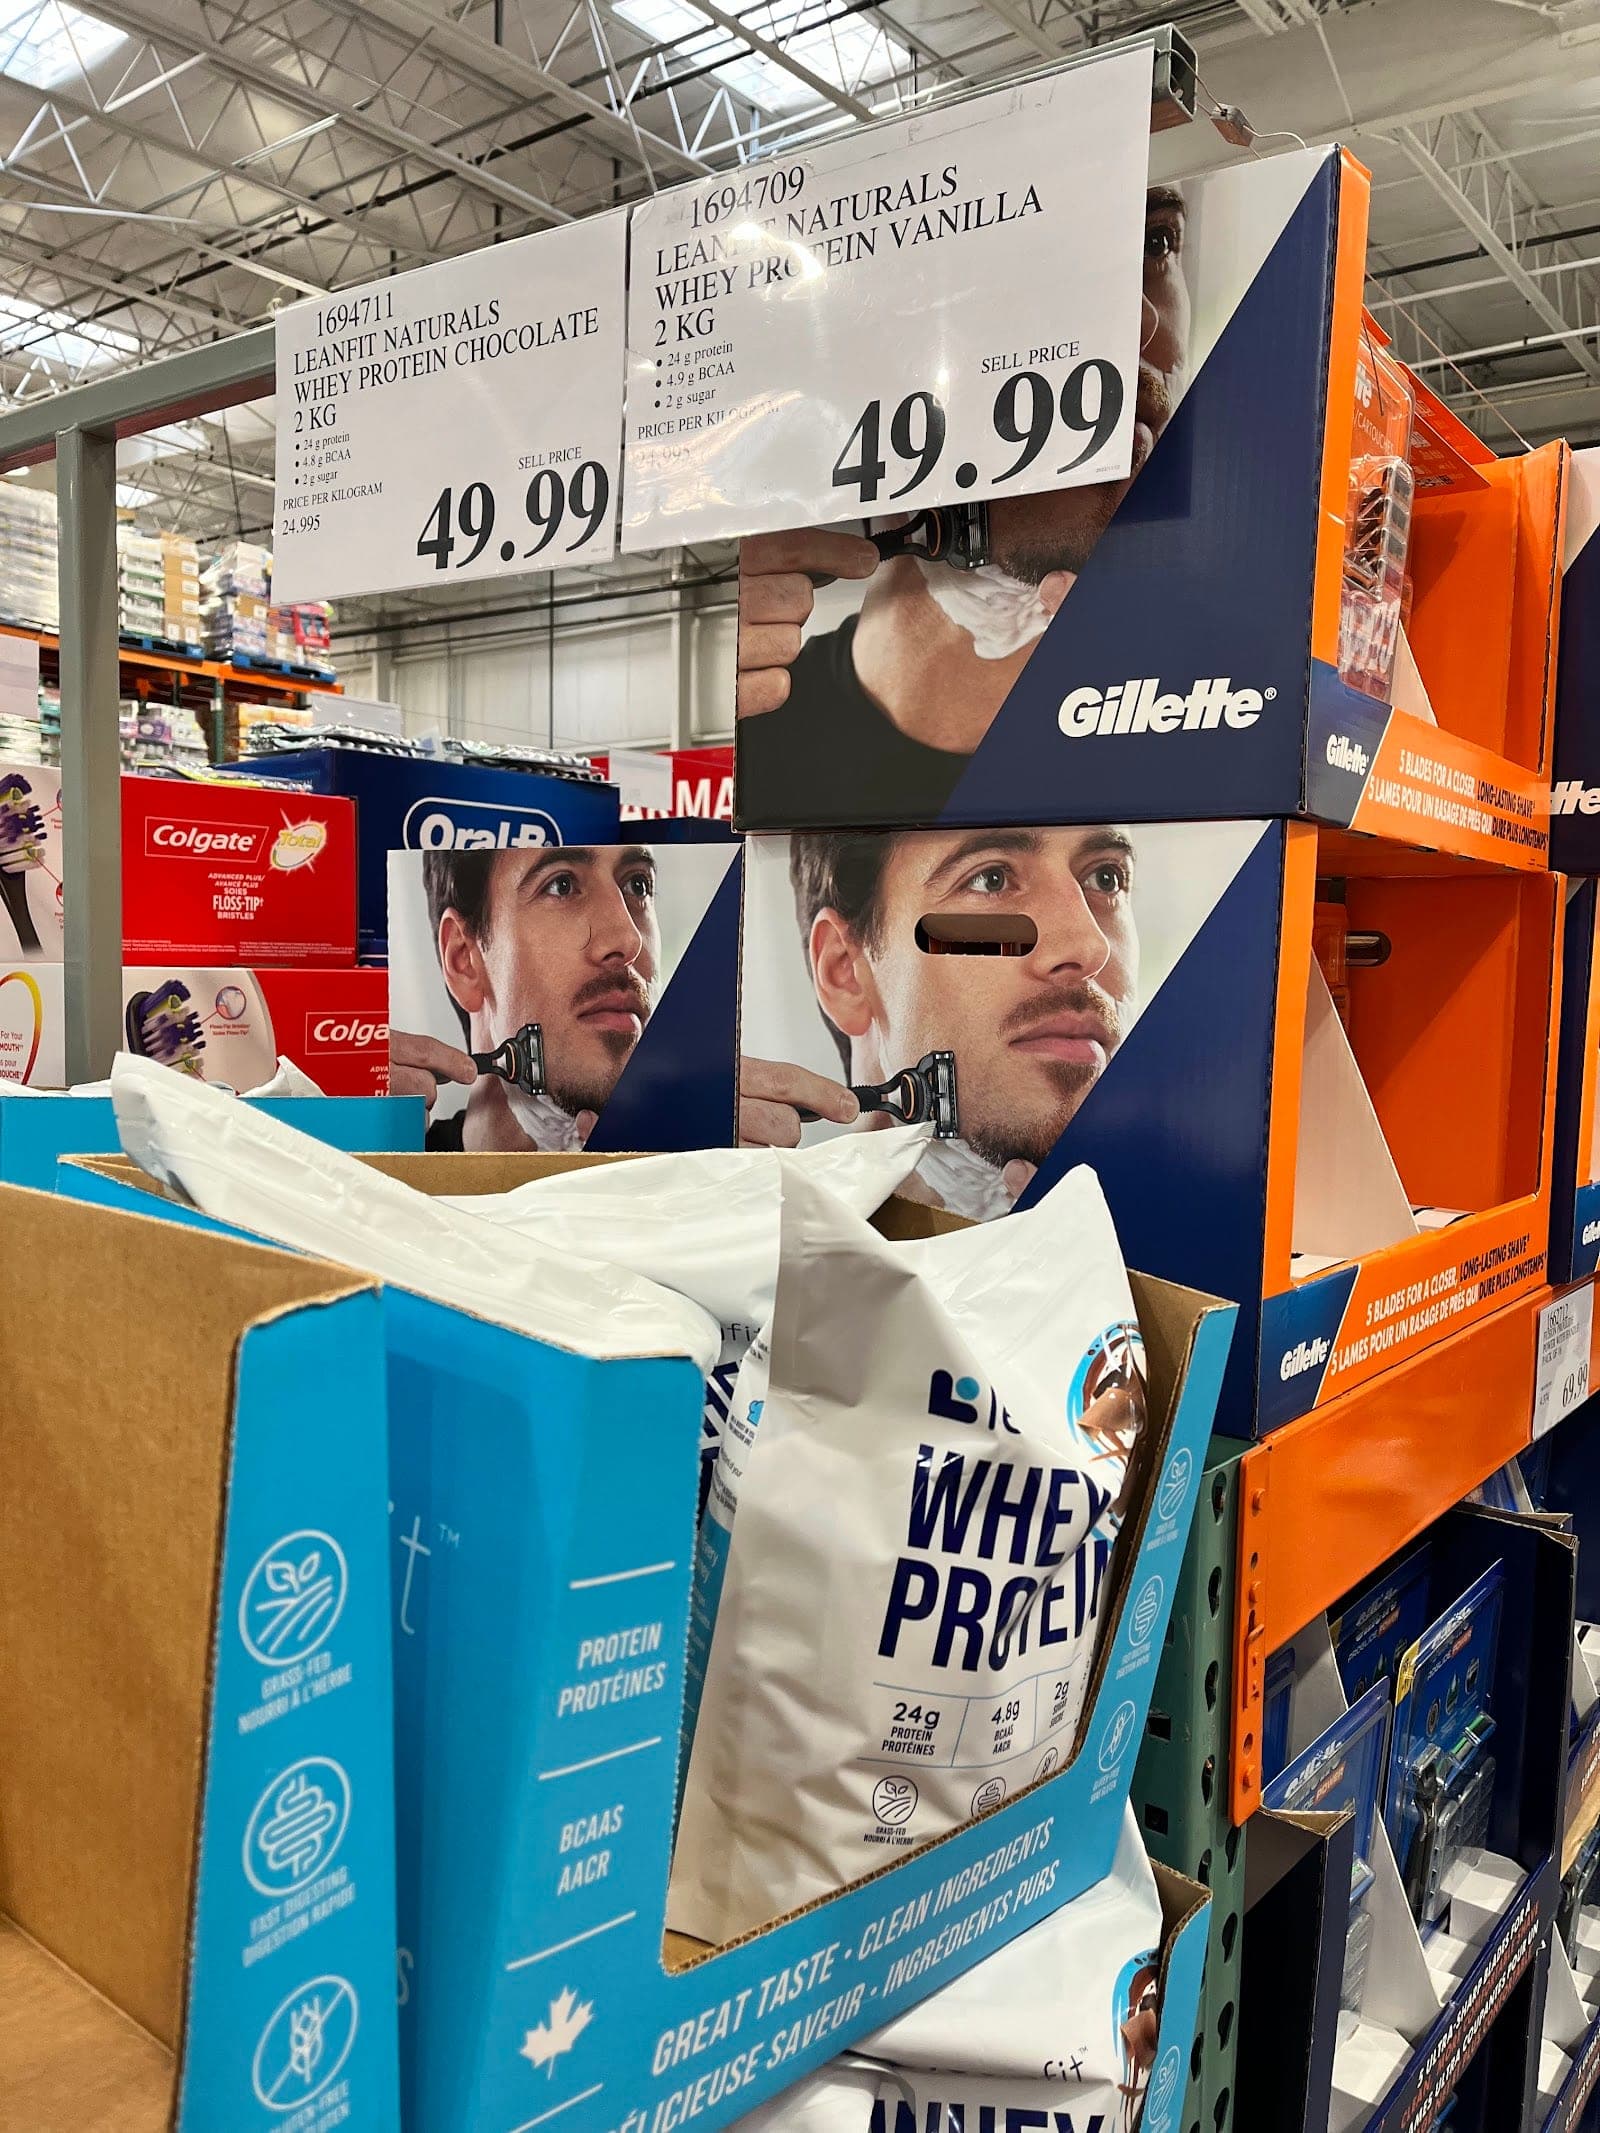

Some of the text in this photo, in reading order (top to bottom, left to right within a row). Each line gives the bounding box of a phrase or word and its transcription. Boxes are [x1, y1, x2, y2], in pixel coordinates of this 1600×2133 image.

[691, 166, 805, 229] 1694709
[786, 165, 958, 240] NATURALS
[655, 265, 739, 311] WHEY
[888, 184, 1044, 249] VANILLA
[316, 291, 394, 338] 1694711
[654, 307, 715, 347] 2 KG
[293, 299, 500, 376] LEANFIT NATURALS
[294, 307, 600, 405] WHEY PROTEIN CHOCOLATE
[667, 340, 733, 367] 24 g protein
[981, 340, 1080, 374] SELL PRICE
[666, 361, 736, 387] 4.9 g BCAA
[294, 403, 337, 433] 2 KG
[665, 388, 716, 410] 2 g sugar
[303, 439, 313, 450] 24
[322, 431, 350, 449] protein
[637, 415, 703, 440] PRICE PER
[832, 358, 1124, 503] 49.99
[302, 455, 316, 467] 4.8
[325, 448, 352, 464] BCAA
[303, 474, 307, 485] 2
[317, 470, 338, 484] sugar
[518, 446, 582, 470] SELL PRICE
[283, 480, 383, 511] PRICE PER KILOGRAM
[417, 460, 609, 570] 49.99
[282, 514, 320, 536] 24.995
[1057, 677, 1264, 738] Gillette
[1326, 734, 1367, 776] Gillette
[1399, 749, 1405, 773] 5
[1405, 751, 1433, 785] BLADES
[1432, 759, 1447, 788] FOR
[1446, 766, 1453, 790] A
[1476, 780, 1516, 815] LONG-LASTING
[1368, 775, 1375, 799] 5
[1375, 778, 1401, 809] LAMES
[1400, 786, 1422, 815] POUR
[1422, 795, 1434, 818] UN
[1434, 798, 1459, 826] RASAGE
[1459, 804, 1467, 827] DE
[1481, 811, 1492, 836] QUI
[1506, 822, 1518, 844] PLUS
[153, 824, 254, 854] Colgate
[279, 829, 321, 849] Total
[223, 887, 248, 896] SOIES
[1366, 1302, 1373, 1327] 5
[1373, 1291, 1405, 1325] BLADES
[1406, 1282, 1422, 1308] FOR
[1422, 1278, 1430, 1300] A
[1460, 1244, 1507, 1282] LONG-LASTING
[1330, 1351, 1338, 1376] 5
[1338, 1336, 1369, 1373] LAMES
[1369, 1328, 1394, 1358] POUR
[1394, 1319, 1409, 1343] UN
[1409, 1302, 1439, 1337] RASAGE
[1439, 1299, 1449, 1322] DE
[1465, 1284, 1479, 1308] QUI
[1479, 1275, 1495, 1301] DURE
[1495, 1268, 1511, 1293] PLUS
[1280, 1337, 1325, 1381] Gillette
[577, 1621, 662, 1671] PROTEIN
[558, 1660, 667, 1718] PROTÉINES
[1054, 1681, 1069, 1701] 2g
[893, 1702, 941, 1729] 24g
[991, 1700, 1020, 1725] 4.8g
[881, 1740, 936, 1756] PROTÉINES
[890, 1726, 933, 1742] PROTEIN
[992, 1740, 1011, 1755] AACR
[559, 1804, 624, 1854] BCAAS
[557, 1849, 610, 1896] AACR
[652, 1816, 1055, 2077] GREAT TASTE CLEAN INGREDIENTS
[766, 1983, 866, 2071] SAVEUR
[882, 1889, 1013, 1998] INGRÉDIENTS
[1012, 1859, 1060, 1914] PURS
